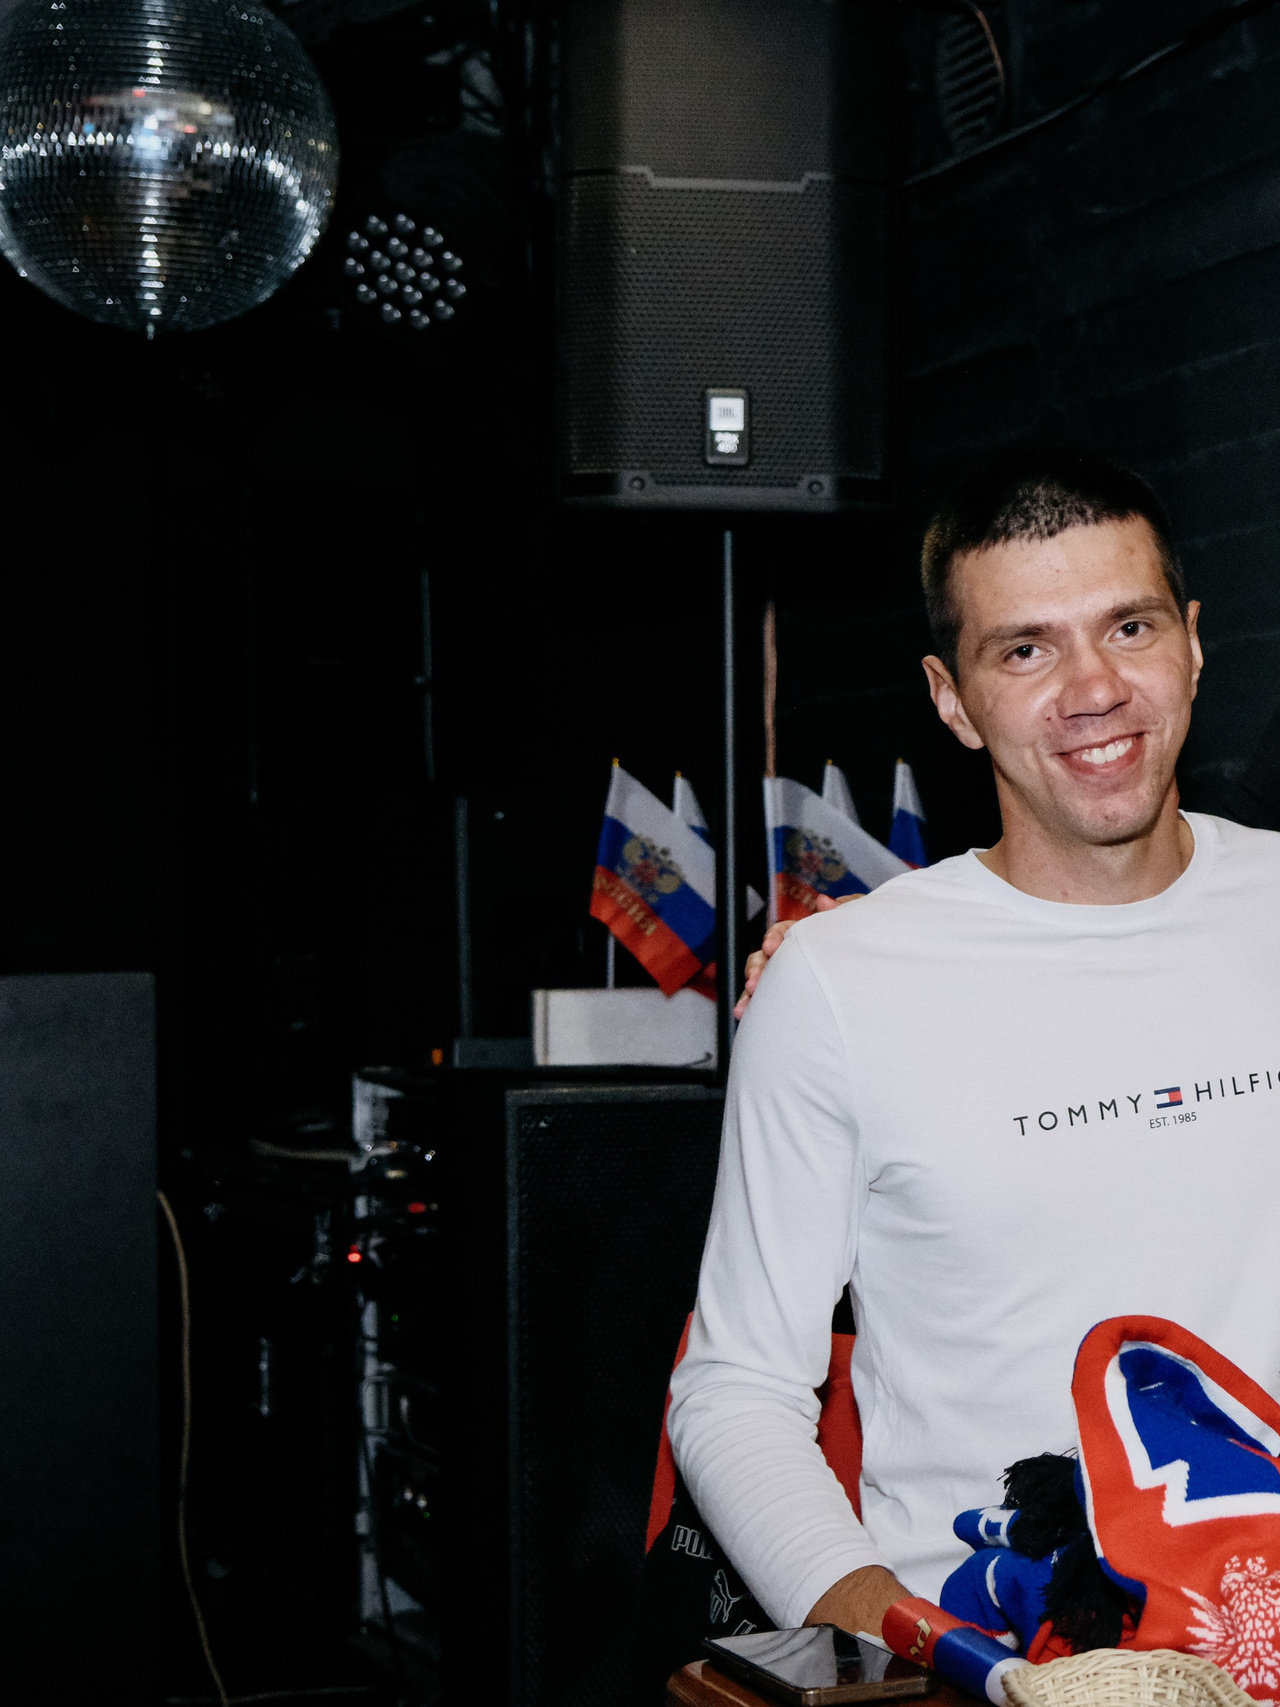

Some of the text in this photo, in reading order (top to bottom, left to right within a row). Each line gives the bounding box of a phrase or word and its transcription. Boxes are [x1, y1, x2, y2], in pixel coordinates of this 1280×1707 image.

[1012, 1093, 1142, 1136] TOMMY
[1149, 1111, 1198, 1130] EST. 1985
